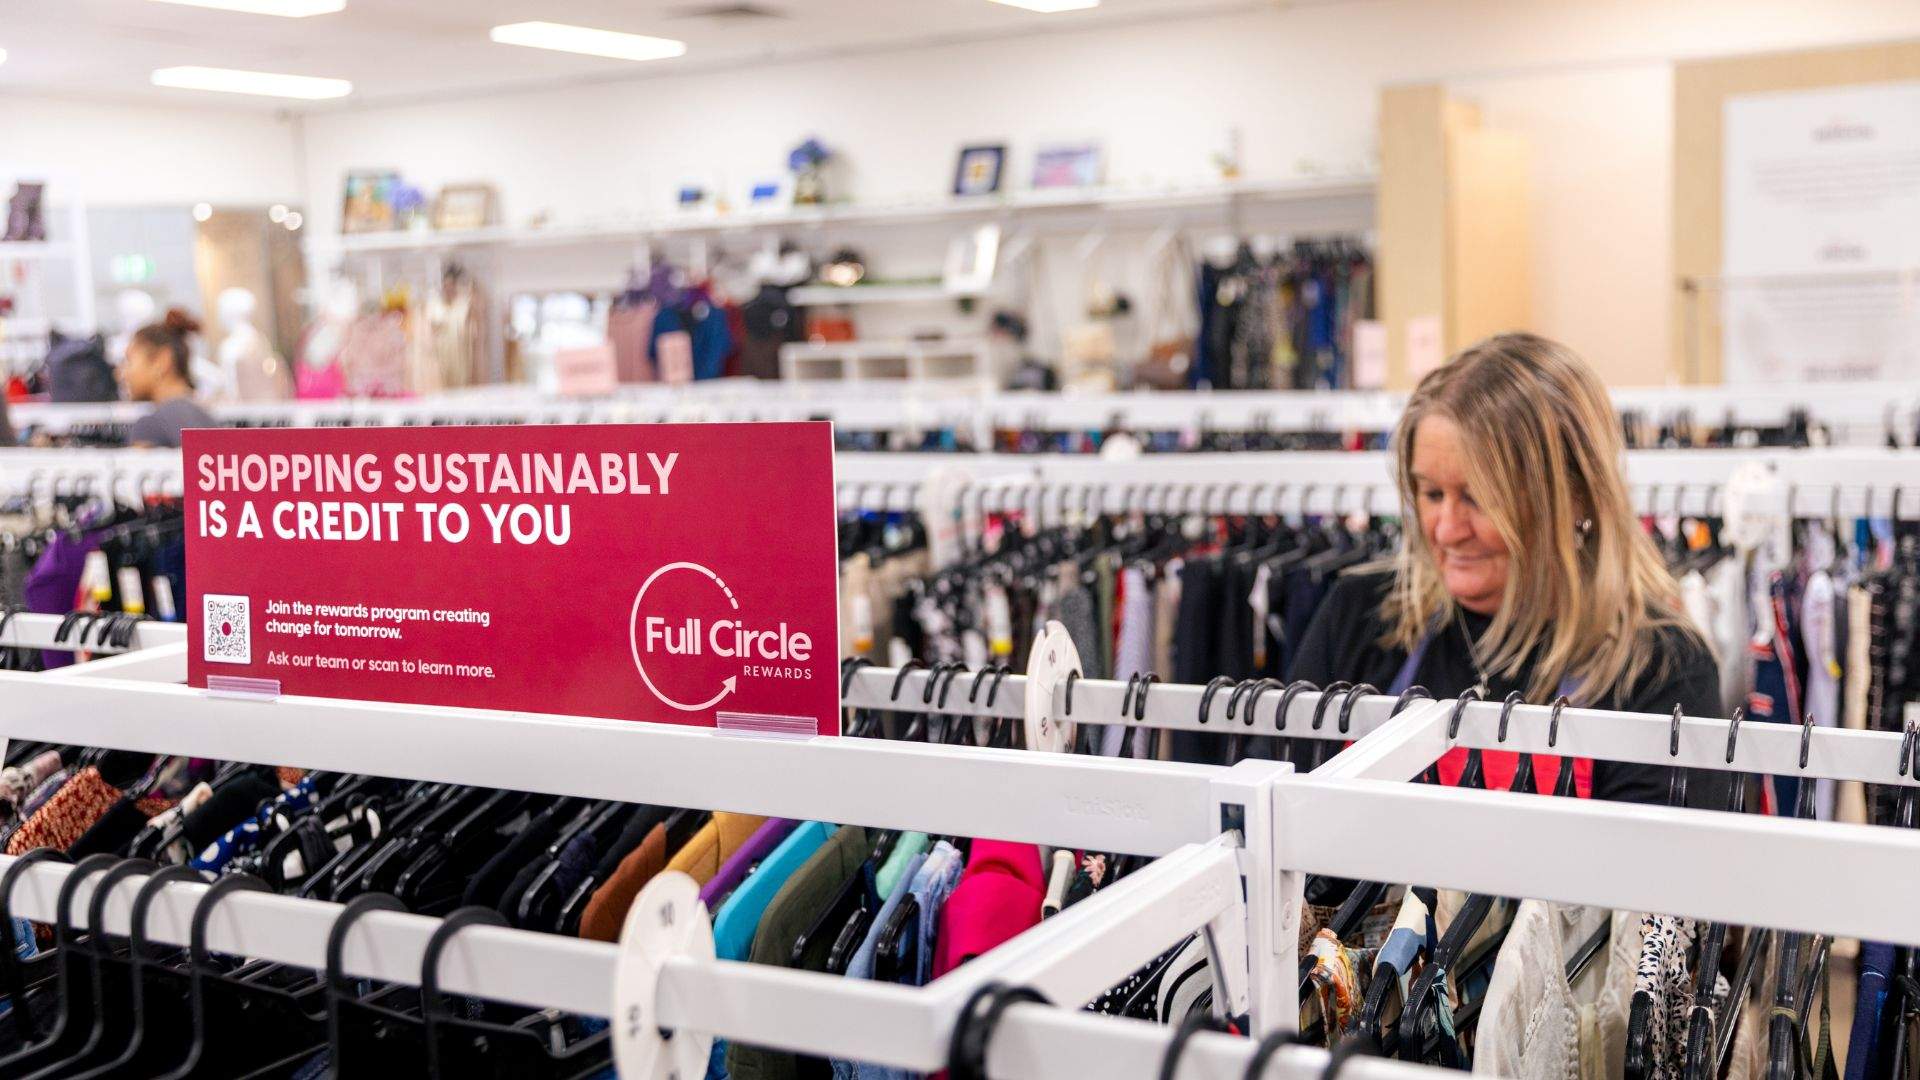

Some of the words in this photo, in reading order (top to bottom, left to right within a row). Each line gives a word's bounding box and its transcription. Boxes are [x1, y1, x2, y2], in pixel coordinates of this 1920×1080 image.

[198, 454, 382, 492] SHOPPING
[394, 453, 679, 494] SUSTAINABLY
[200, 500, 227, 537] IS
[237, 501, 263, 538] A
[273, 501, 404, 541] CREDIT
[416, 503, 469, 543] TO
[481, 504, 570, 545] YOU
[265, 600, 290, 614] Join
[293, 601, 313, 615] the
[316, 604, 368, 618] rewards
[371, 608, 430, 623] program
[433, 608, 489, 627] creating
[266, 619, 311, 637] change
[314, 621, 332, 635] for
[334, 622, 402, 639] tomorrow.
[646, 617, 701, 654] Full
[709, 620, 812, 661] Circle
[266, 651, 289, 665] Ask
[292, 655, 313, 666] our
[316, 655, 349, 669] team
[352, 659, 365, 669] or
[369, 660, 399, 672] scan
[402, 660, 415, 673] to
[419, 660, 453, 675] learn
[456, 665, 495, 678] more.
[744, 666, 811, 679] REWARDS
